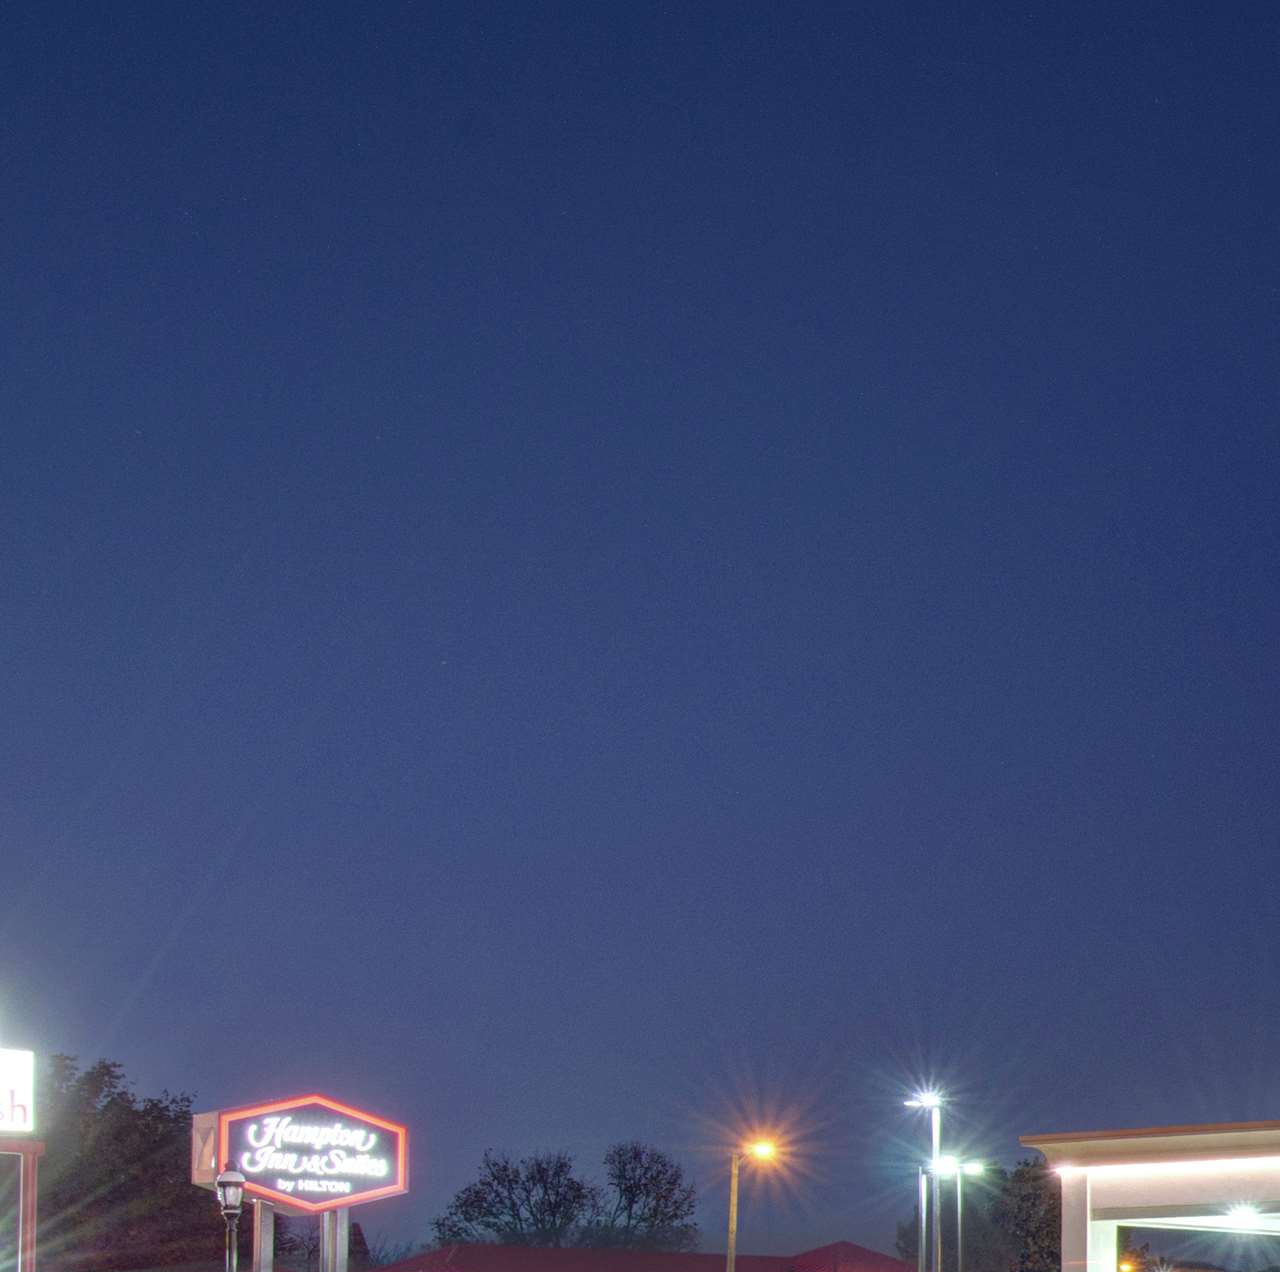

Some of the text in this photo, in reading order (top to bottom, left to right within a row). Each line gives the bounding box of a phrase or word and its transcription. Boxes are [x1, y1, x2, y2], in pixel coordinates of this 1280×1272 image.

[247, 1115, 376, 1151] Hampton
[240, 1146, 388, 1177] Inn & Suites
[276, 1178, 352, 1193] by HILTON
